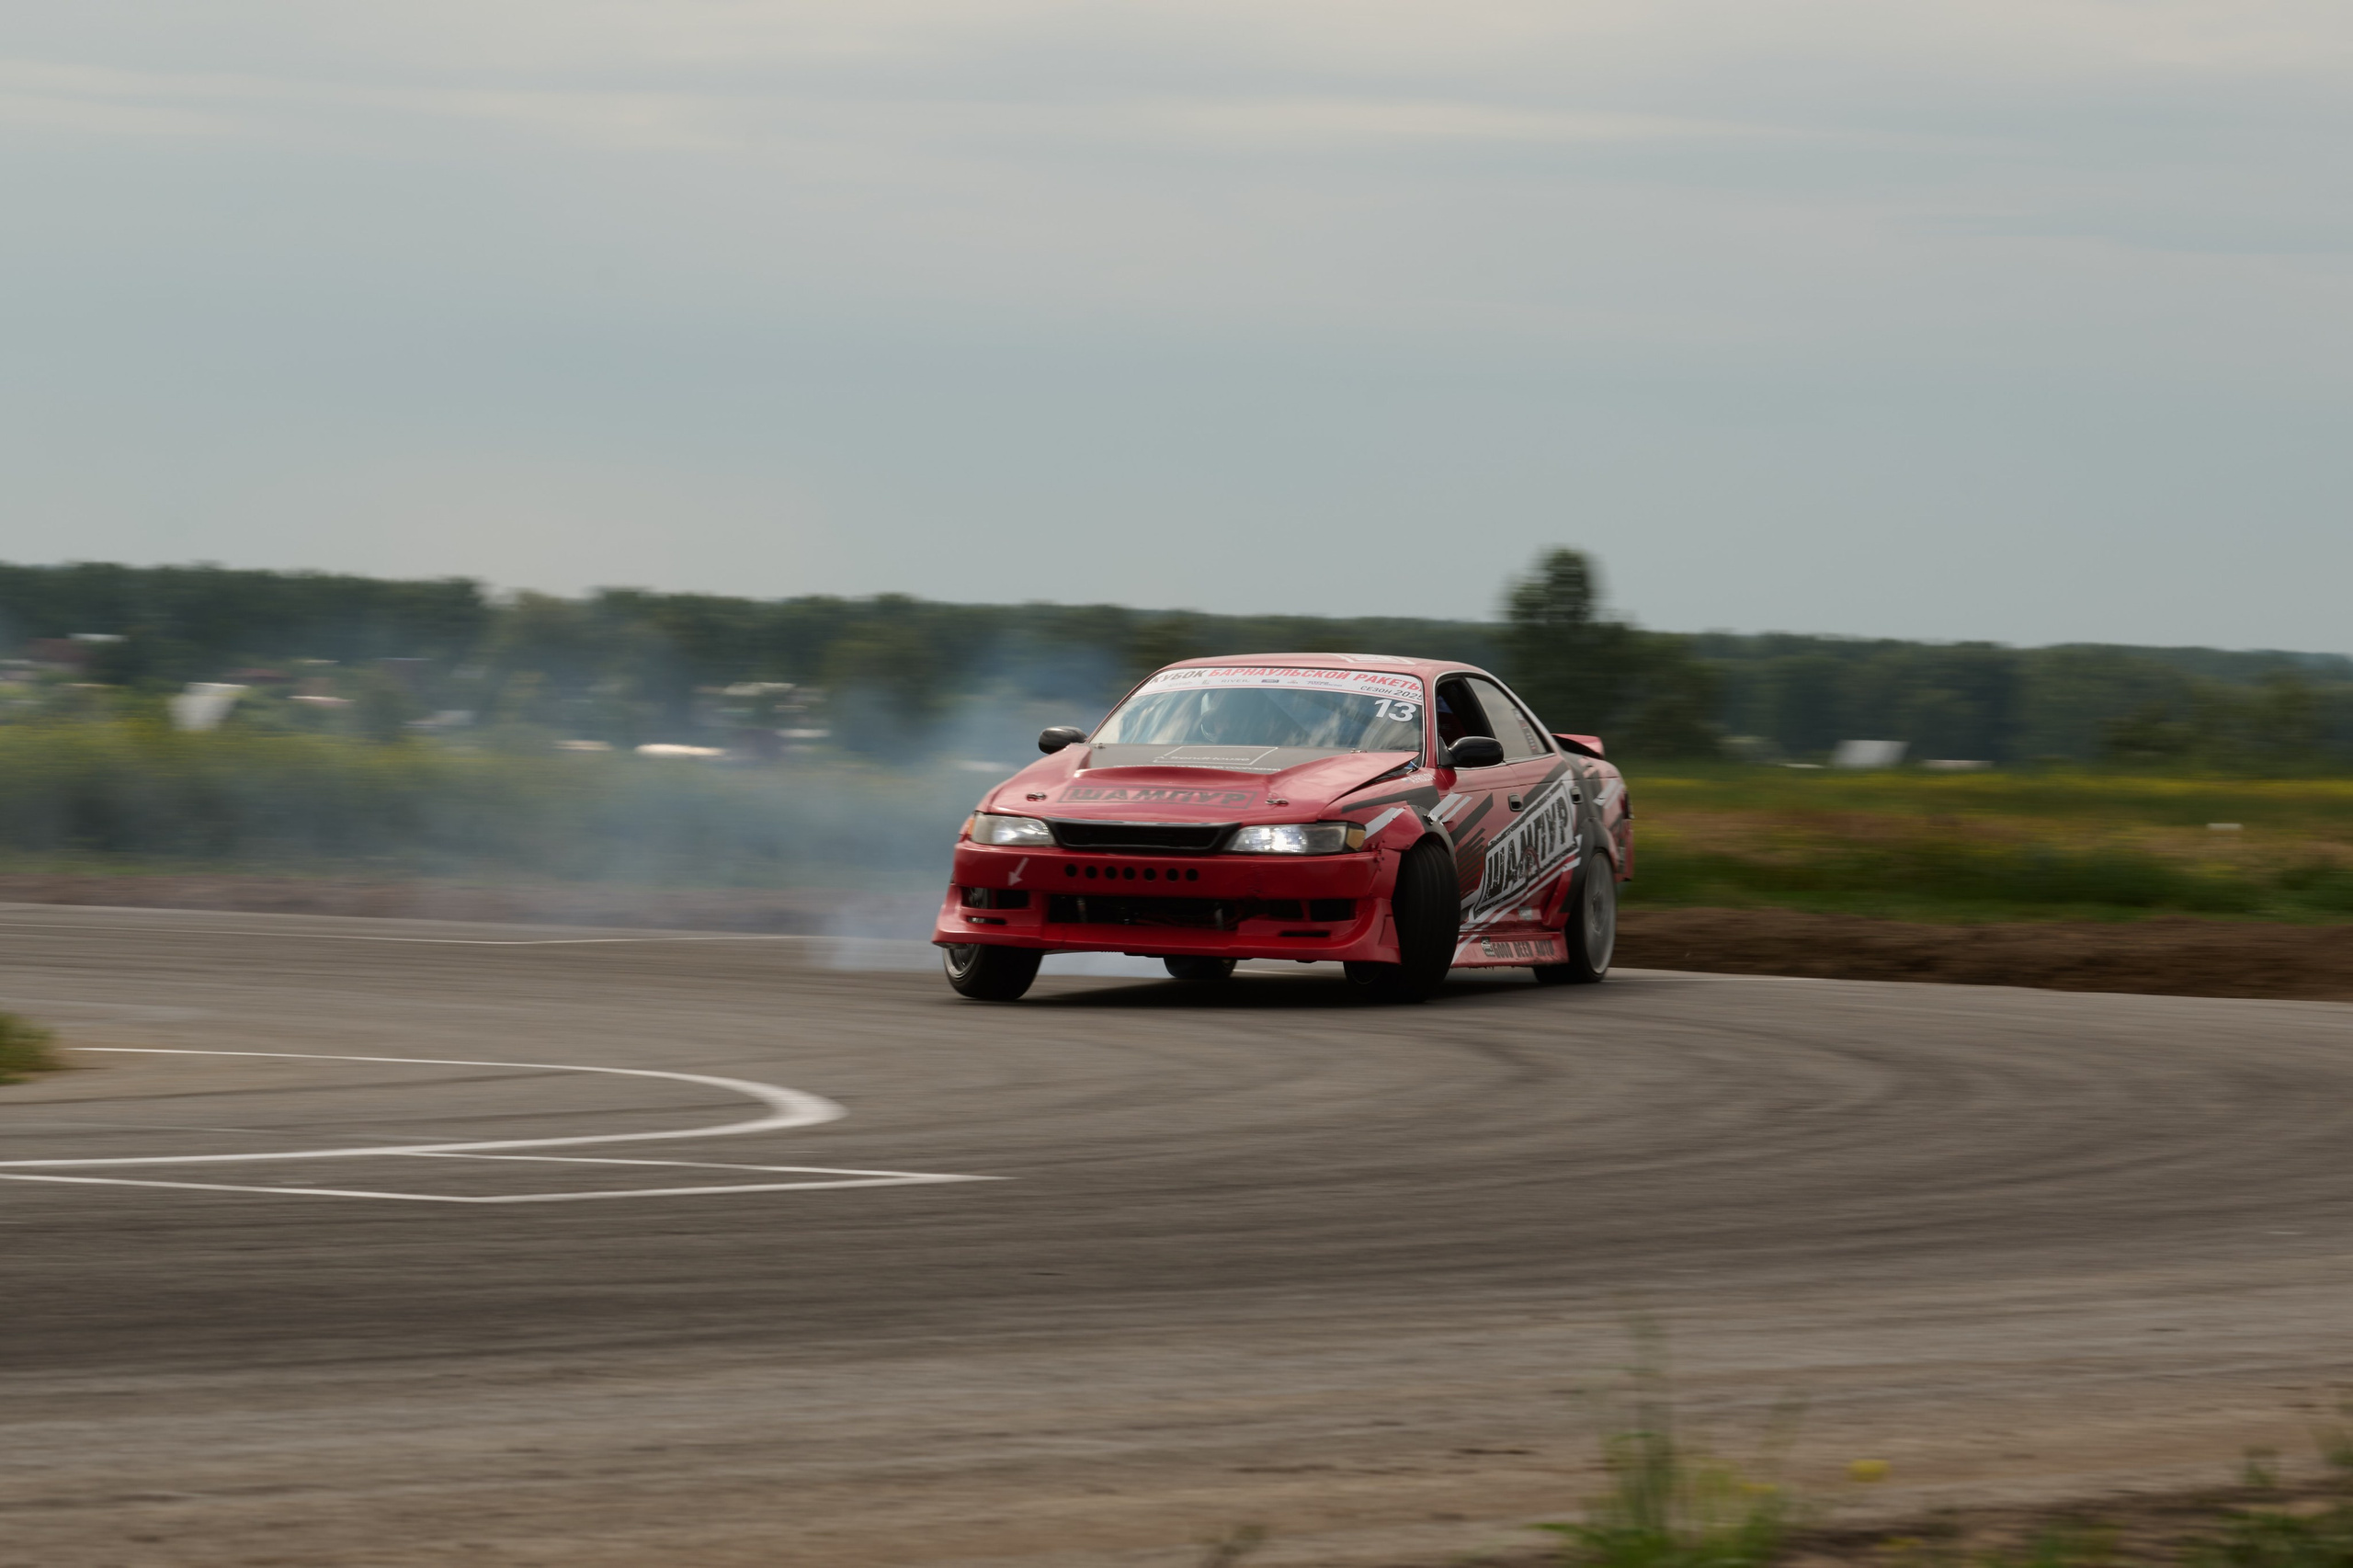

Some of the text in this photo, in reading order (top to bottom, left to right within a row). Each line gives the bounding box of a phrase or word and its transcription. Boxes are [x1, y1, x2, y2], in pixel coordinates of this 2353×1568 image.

[1149, 669, 1207, 684] КУБОК
[1208, 668, 1351, 680] БАРНАУЛЬСКОЙ
[1359, 686, 1392, 694] СЕЗОН
[1374, 699, 1416, 722] 13
[1070, 788, 1247, 807] ШАМПУР
[1483, 796, 1570, 903] ШАМПУР
